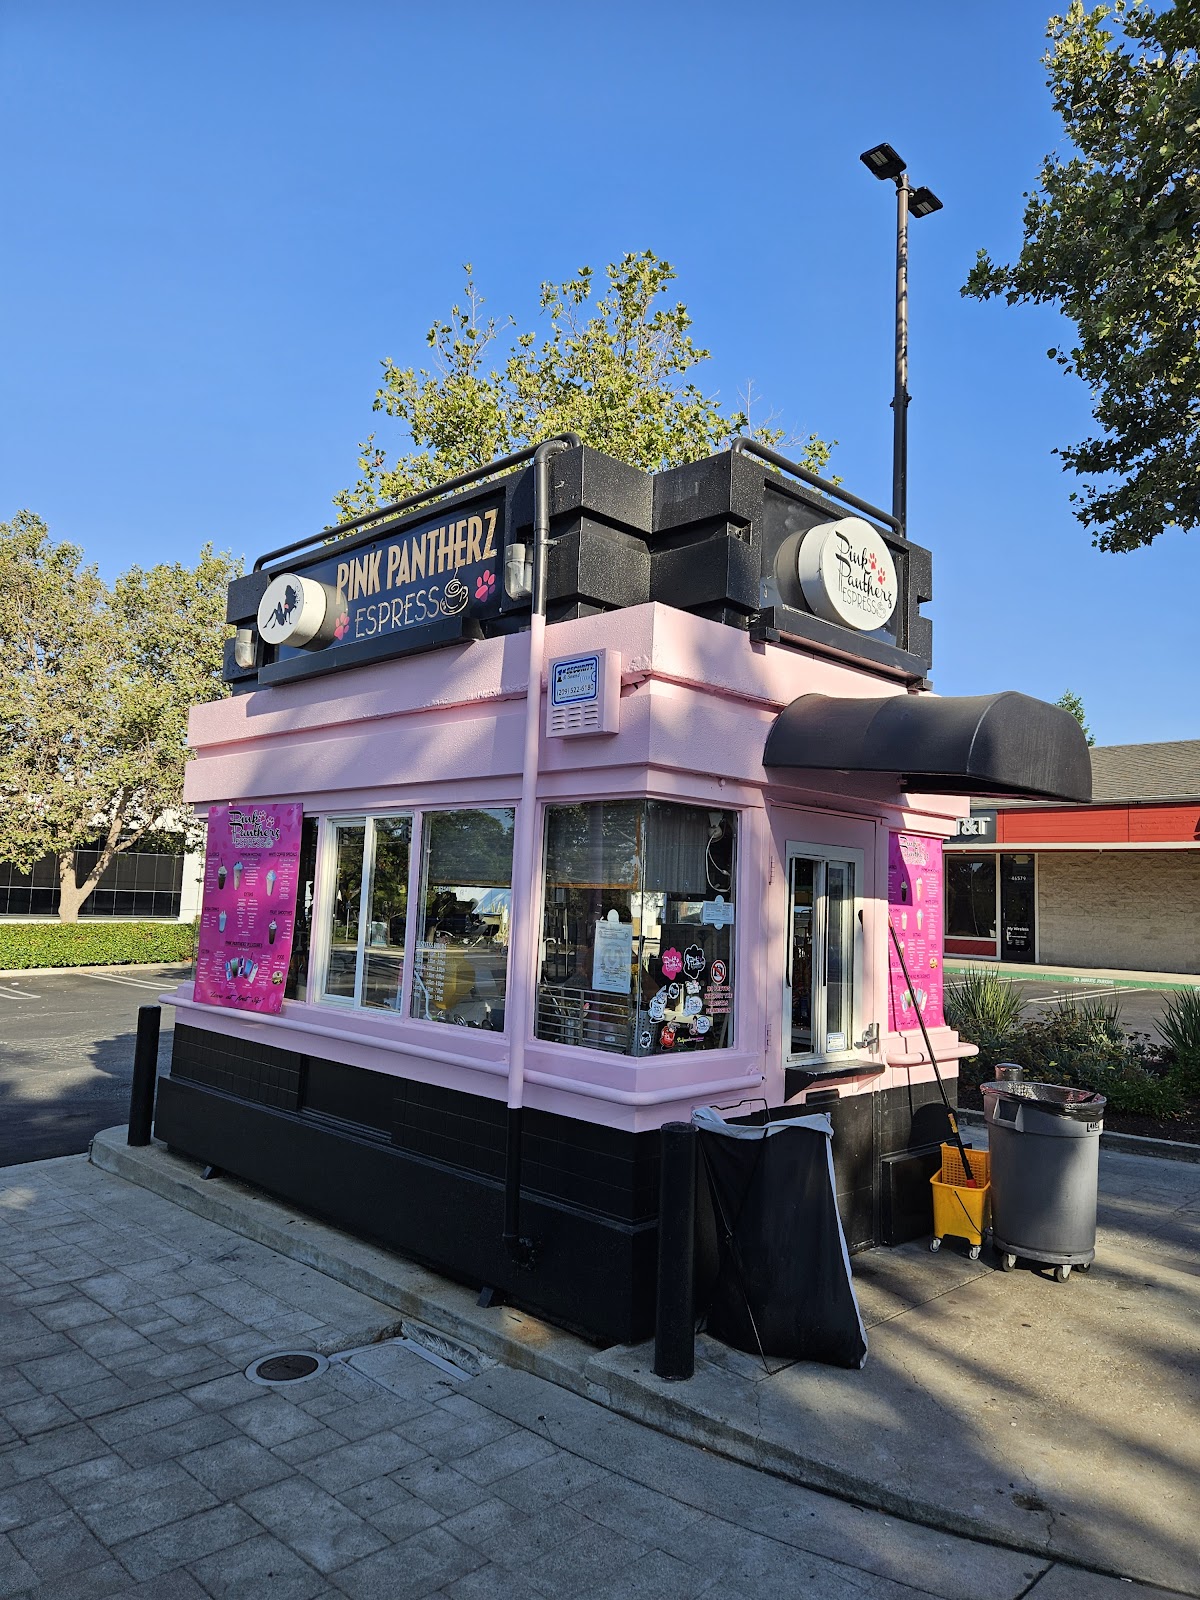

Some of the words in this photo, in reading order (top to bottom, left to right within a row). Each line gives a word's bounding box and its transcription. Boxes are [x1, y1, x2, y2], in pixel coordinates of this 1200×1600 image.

[335, 549, 383, 605] PINK
[386, 508, 500, 590] PANTHERZ
[835, 530, 869, 570] Pink
[835, 553, 893, 609] Pantherz
[228, 809, 259, 826] Pink
